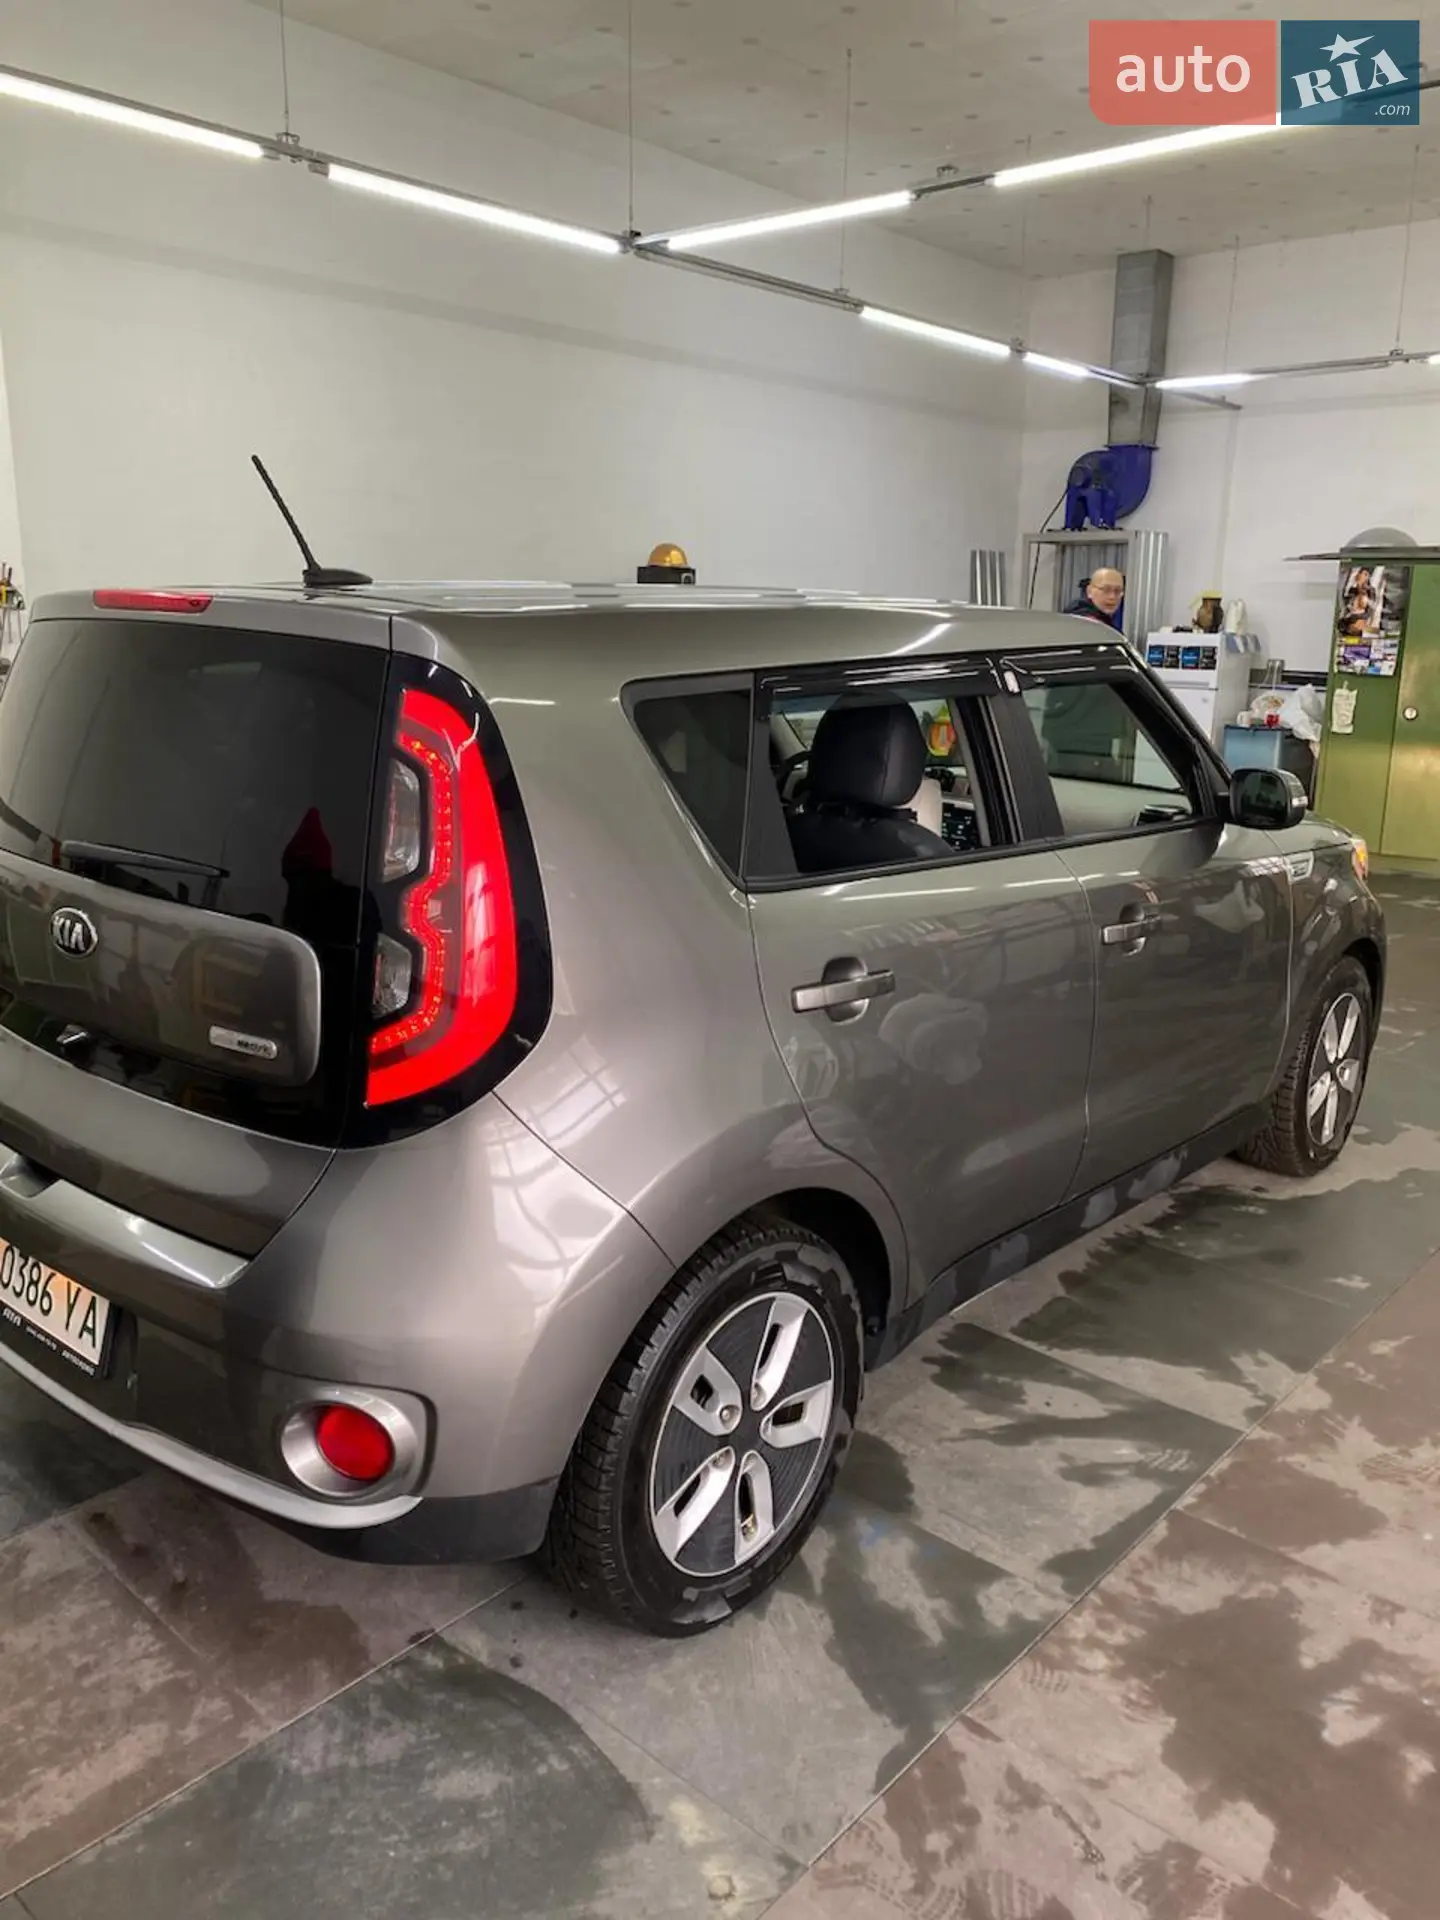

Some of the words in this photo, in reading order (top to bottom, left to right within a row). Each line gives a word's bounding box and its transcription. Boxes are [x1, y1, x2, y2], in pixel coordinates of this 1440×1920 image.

[53, 916, 85, 950] KIA
[1, 1246, 56, 1316] 0386
[65, 1281, 97, 1349] YA
